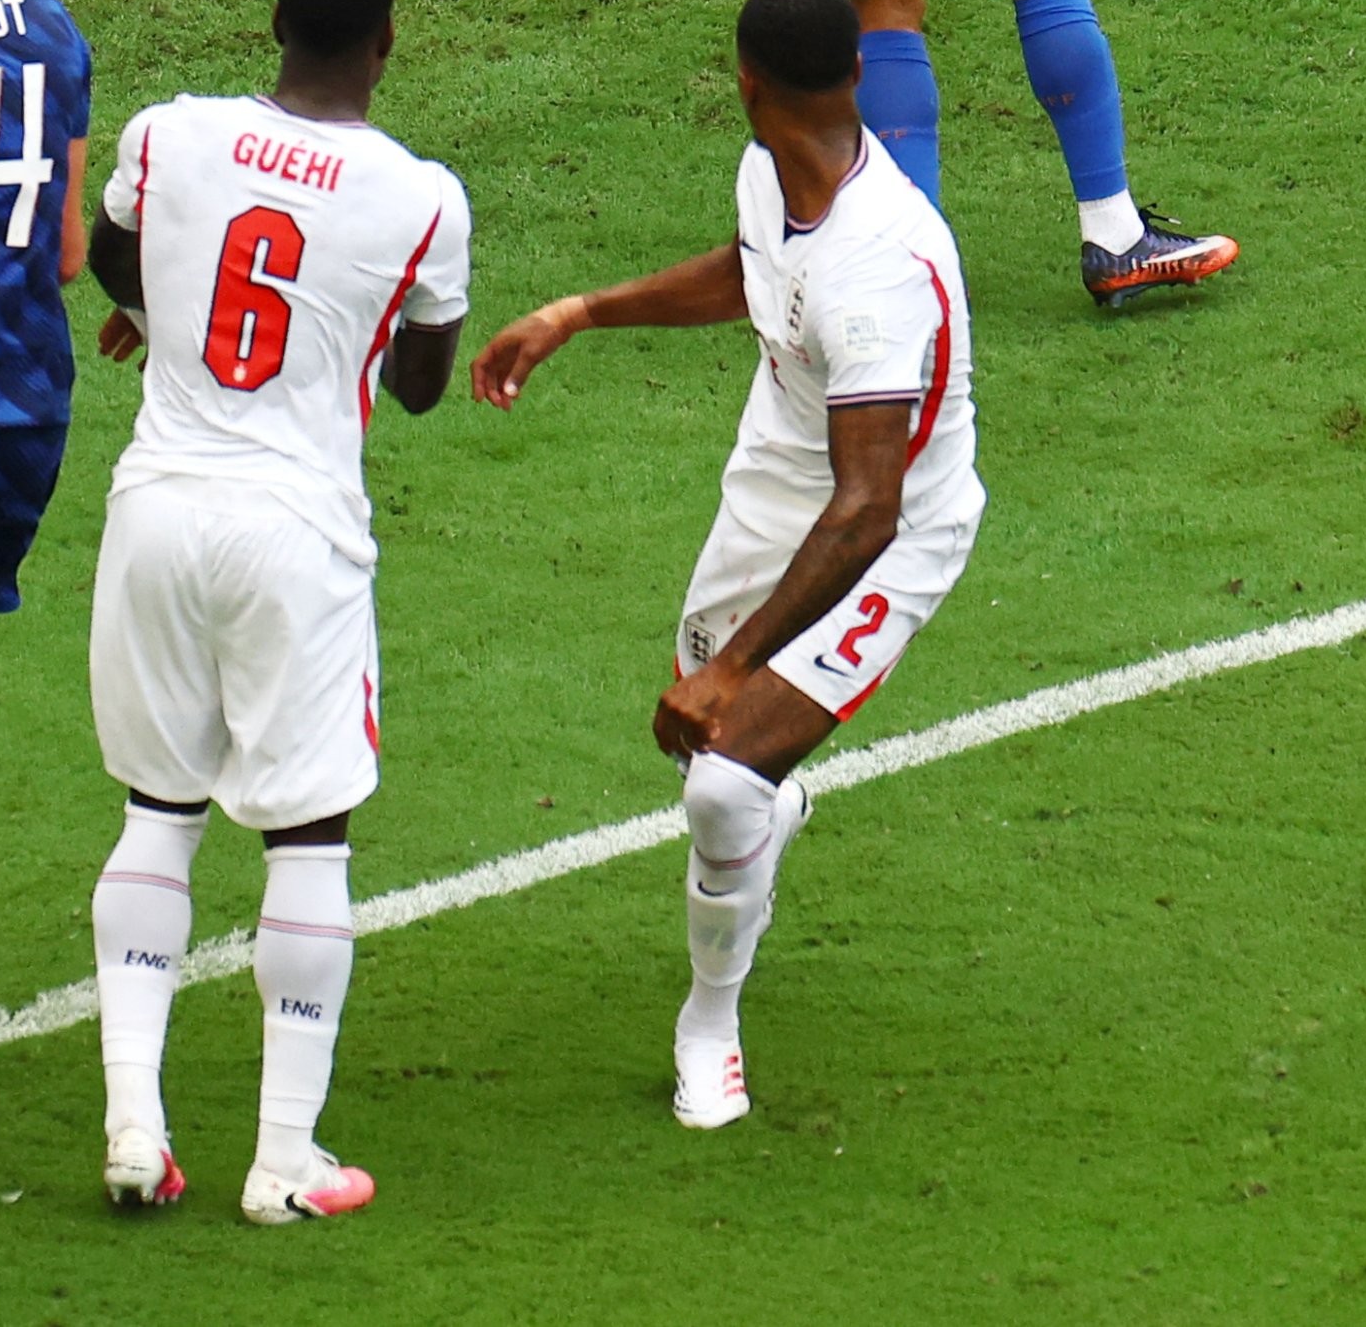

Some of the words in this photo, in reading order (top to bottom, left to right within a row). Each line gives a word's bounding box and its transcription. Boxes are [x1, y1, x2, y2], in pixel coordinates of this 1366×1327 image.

[233, 133, 345, 192] GUÉHI
[202, 205, 306, 392] 6
[836, 591, 889, 668] 2
[124, 949, 171, 971] ENG
[281, 997, 323, 1021] ENG
